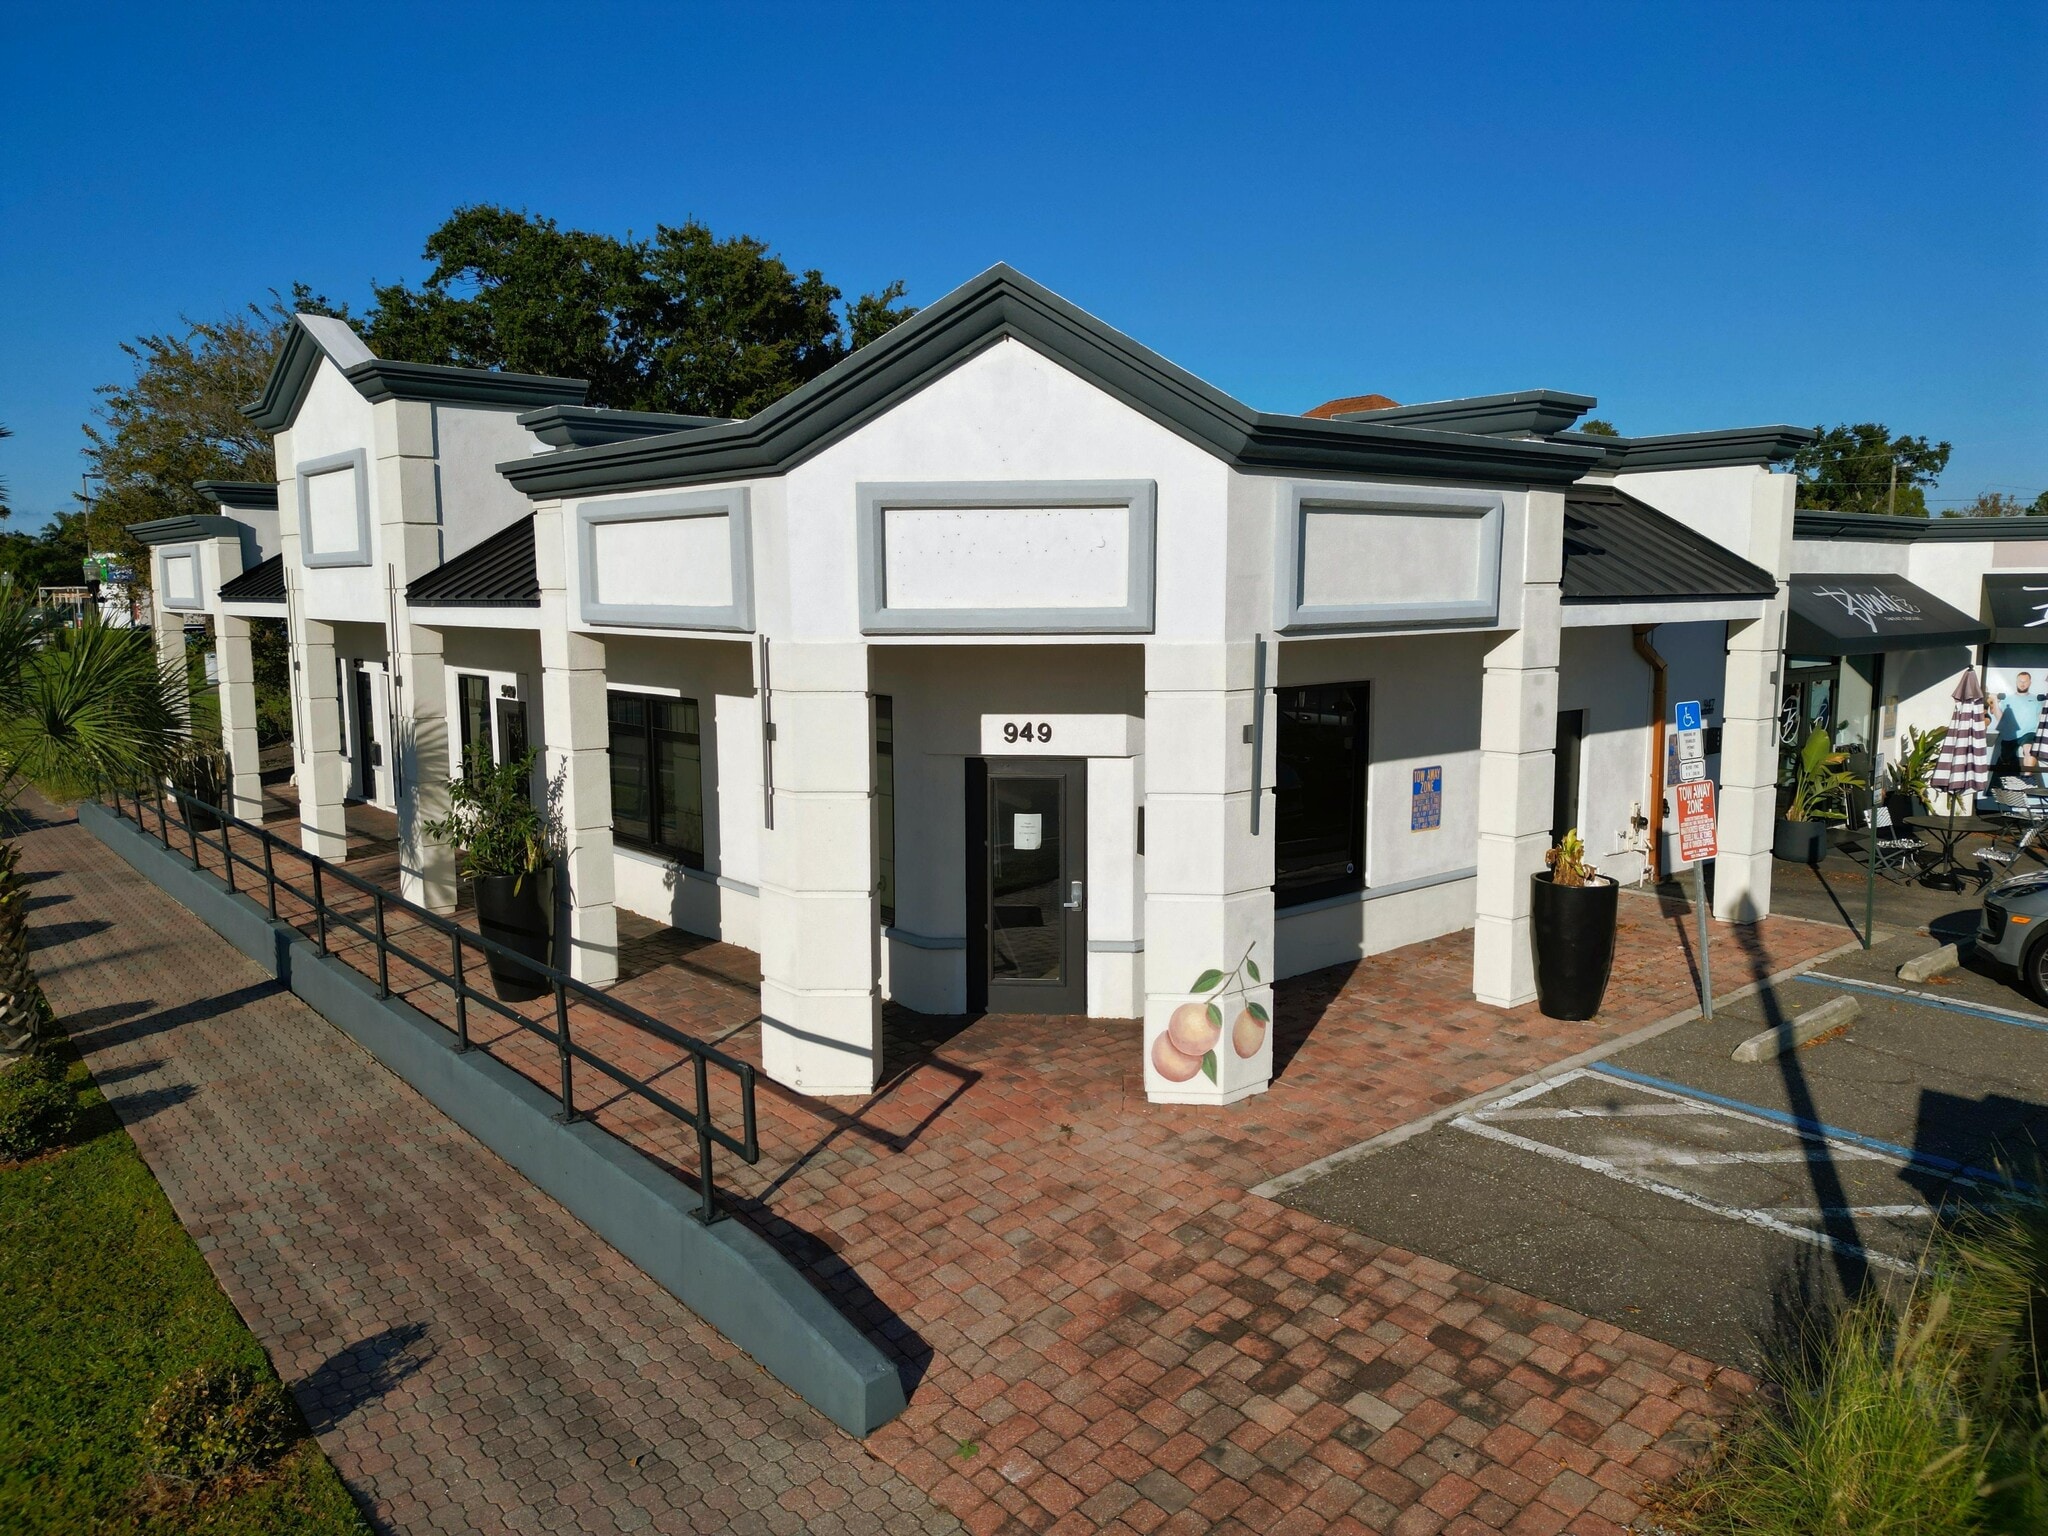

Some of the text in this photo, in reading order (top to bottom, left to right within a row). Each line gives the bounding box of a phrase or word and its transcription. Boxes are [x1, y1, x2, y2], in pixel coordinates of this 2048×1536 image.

[1003, 722, 1052, 743] 949
[1414, 769, 1440, 783] TOW AWAY
[1420, 781, 1434, 793] ZONE
[1678, 782, 1711, 802] TOW AWAY
[1686, 799, 1704, 815] ZONE
